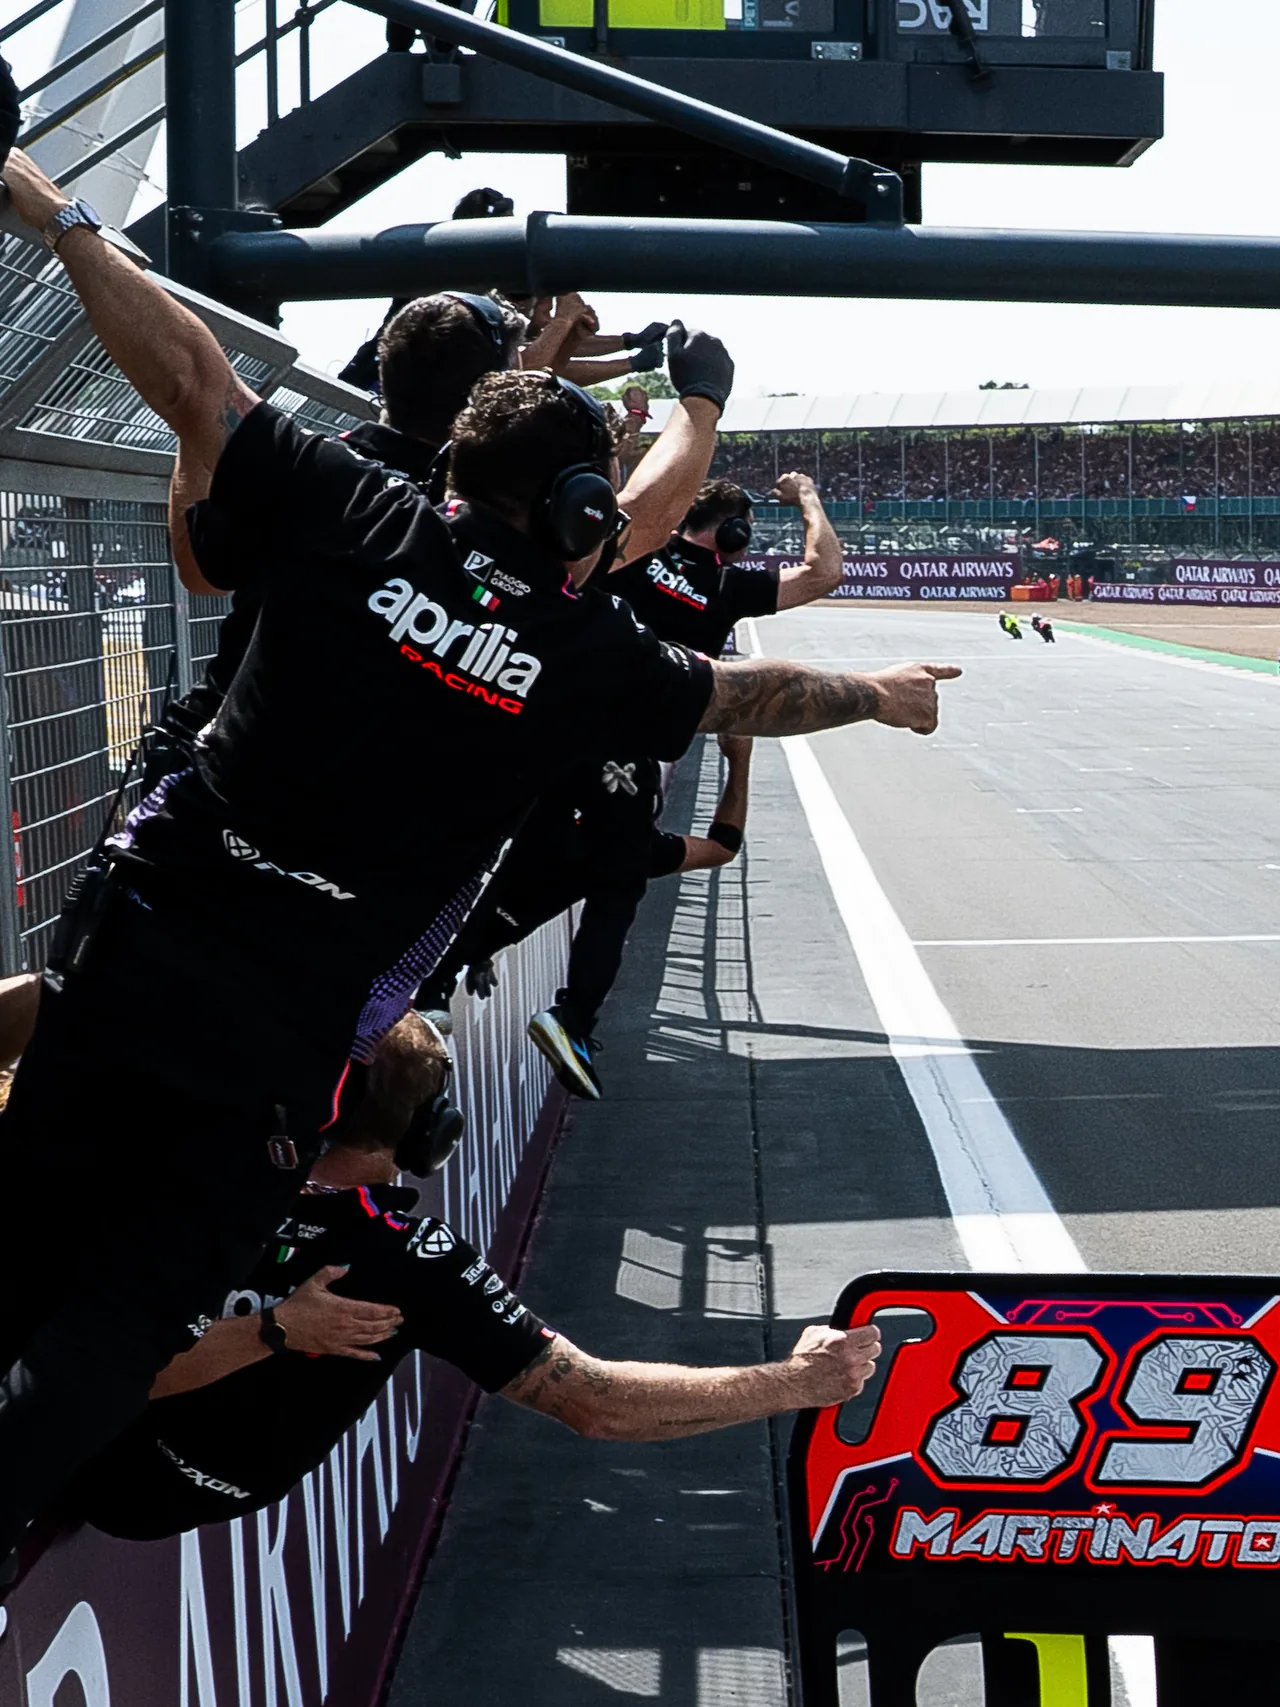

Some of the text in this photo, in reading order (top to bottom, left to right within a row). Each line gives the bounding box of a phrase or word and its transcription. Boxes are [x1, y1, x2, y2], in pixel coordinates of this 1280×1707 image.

[494, 569, 531, 593] PIAGGIO
[646, 558, 708, 605] aprilia
[899, 562, 947, 578] QATAR
[952, 562, 1014, 578] AIRWAYS
[1175, 564, 1256, 585] QATAR AIRWAYS
[490, 577, 524, 597] GROUP
[829, 585, 911, 598] ATAR AIRWAYS
[920, 586, 1006, 599] QATAR AIRWAYS
[367, 577, 542, 699] aprilia
[399, 644, 524, 715] RACING
[920, 1330, 1276, 1488] 89
[179, 1466, 252, 1499] IXON
